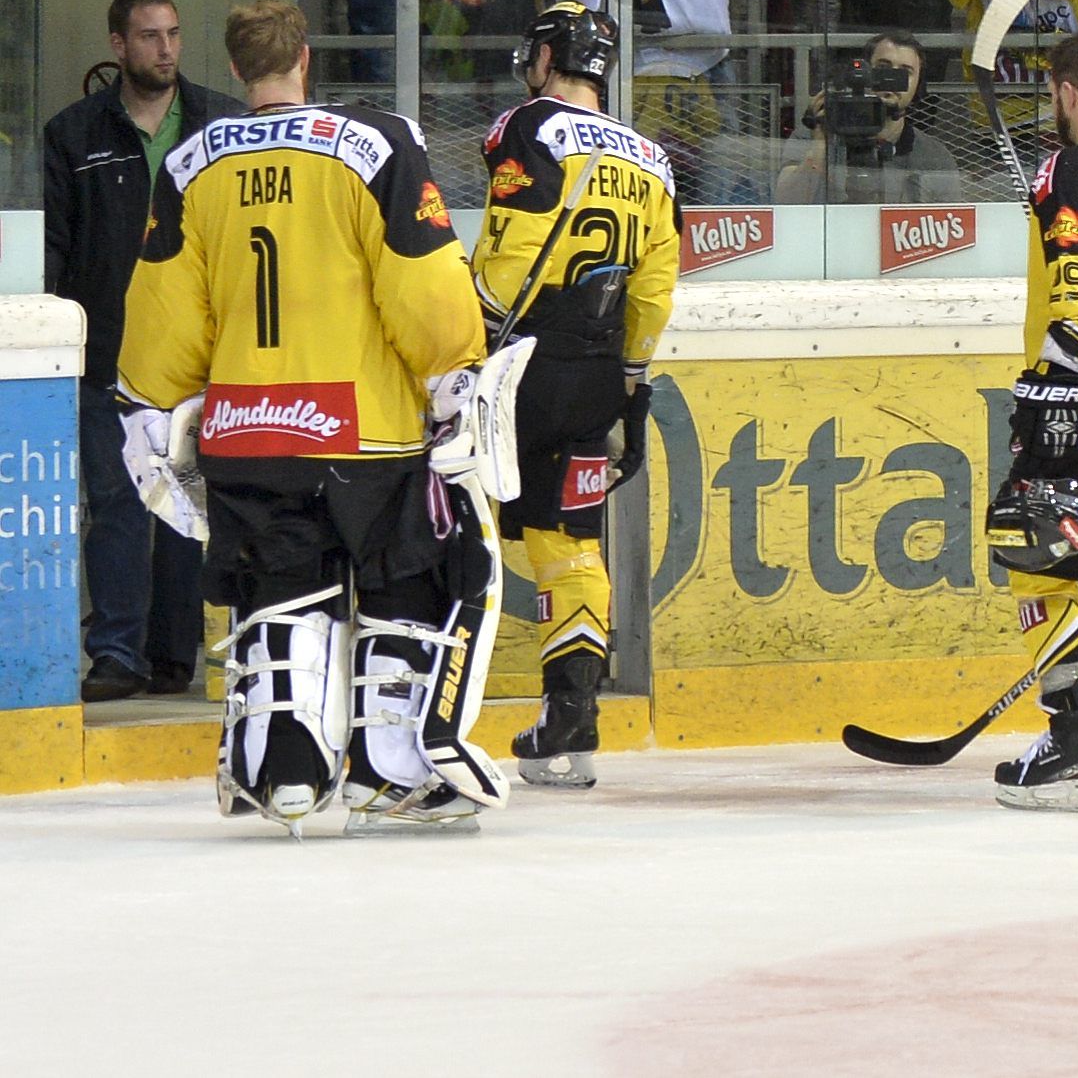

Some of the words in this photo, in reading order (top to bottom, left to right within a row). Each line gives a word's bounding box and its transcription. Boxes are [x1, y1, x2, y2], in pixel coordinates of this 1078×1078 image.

[209, 117, 305, 153] ERSTE
[342, 128, 380, 164] Zitta
[575, 123, 638, 162] ERSTE
[236, 165, 294, 208] ZABA
[690, 214, 762, 255] Kelly's
[892, 212, 964, 253] Kelly's
[250, 225, 280, 349] 1
[202, 397, 341, 440] Almdudler
